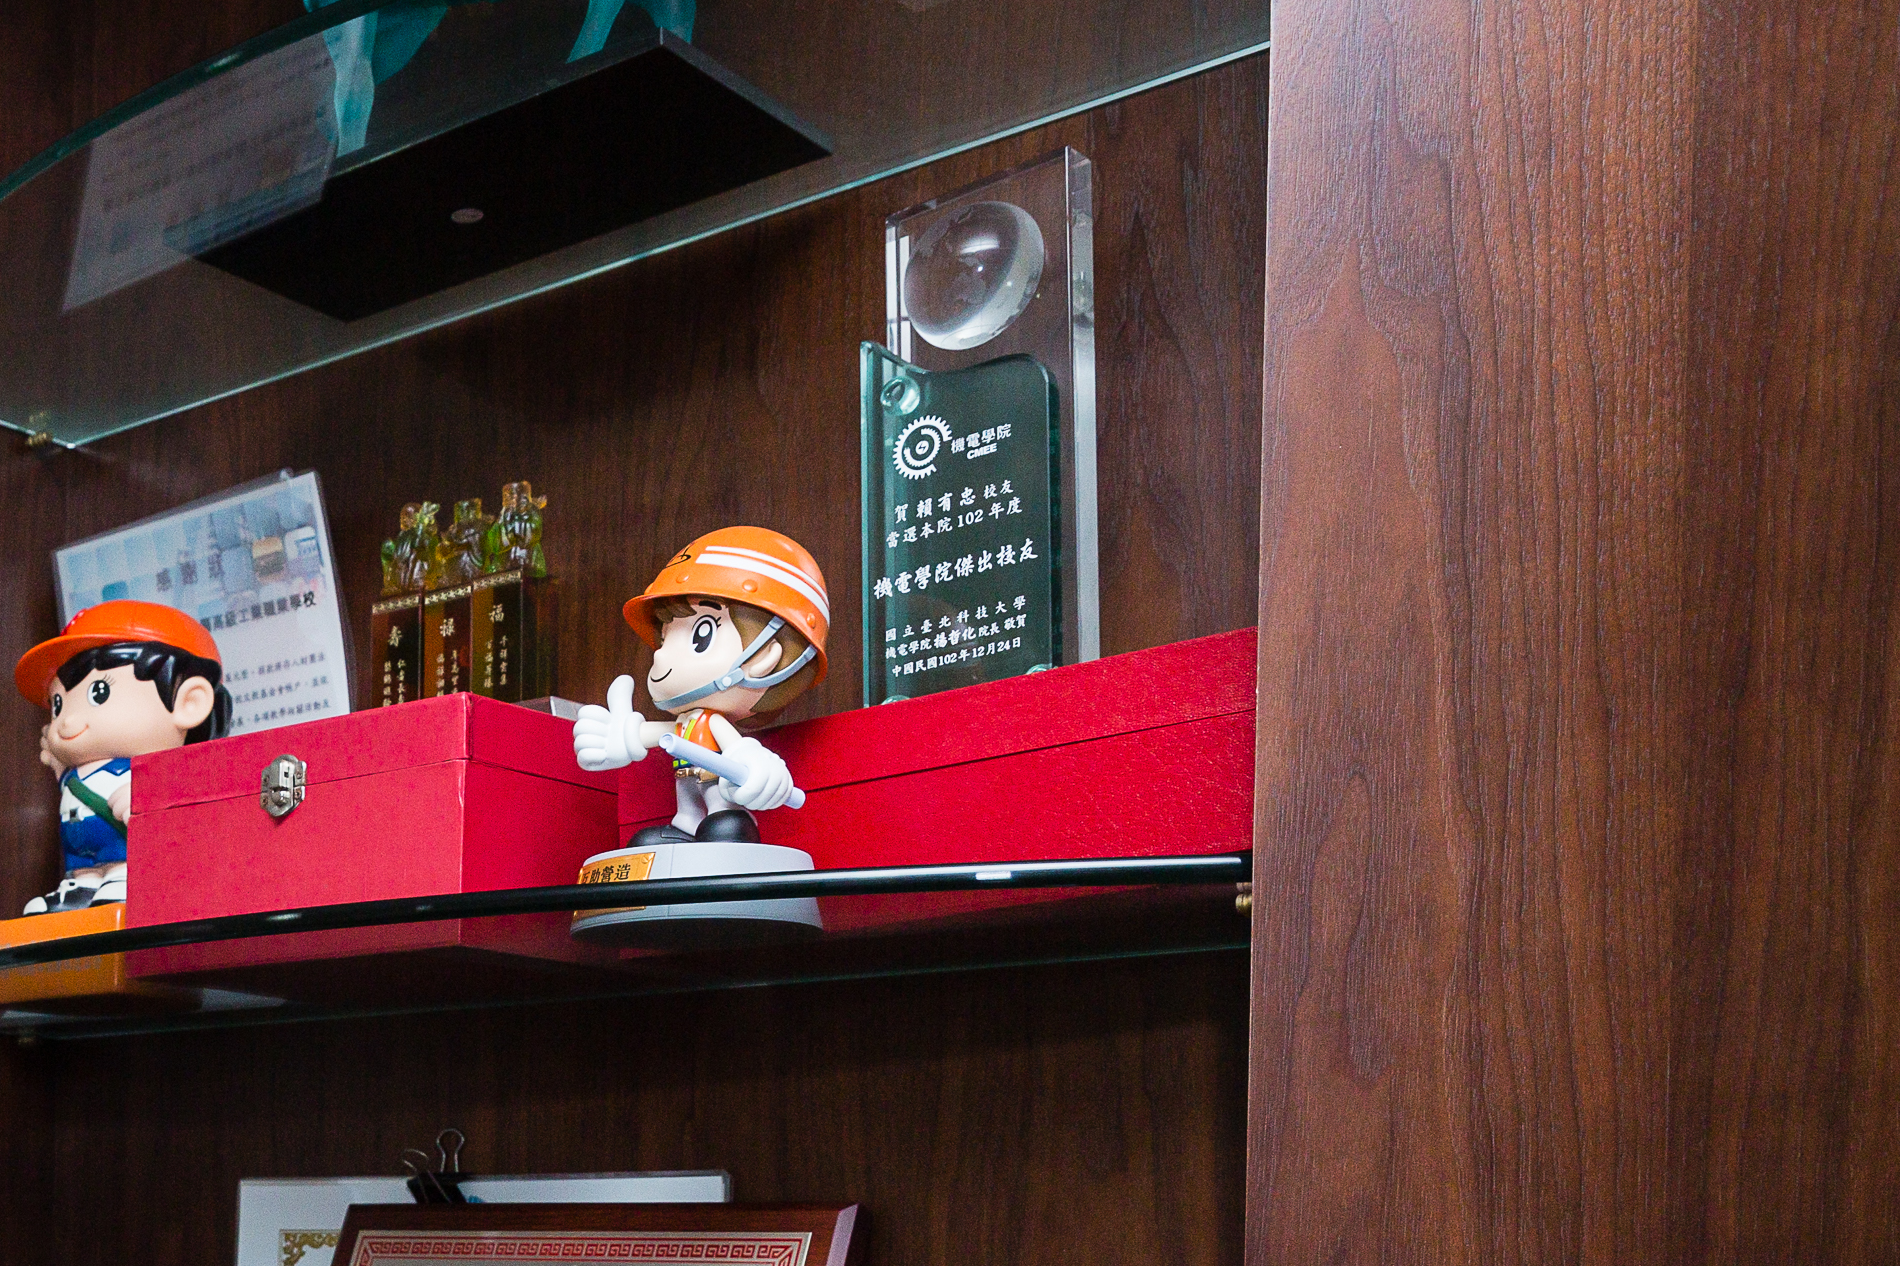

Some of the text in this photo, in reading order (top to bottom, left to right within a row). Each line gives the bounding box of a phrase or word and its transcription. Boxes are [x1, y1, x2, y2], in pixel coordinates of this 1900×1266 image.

[951, 423, 1012, 454] 機電學院
[967, 443, 998, 459] CMEE
[874, 538, 1038, 599] 機電學院傑出校友
[886, 595, 1026, 642] 國立臺北科技大學
